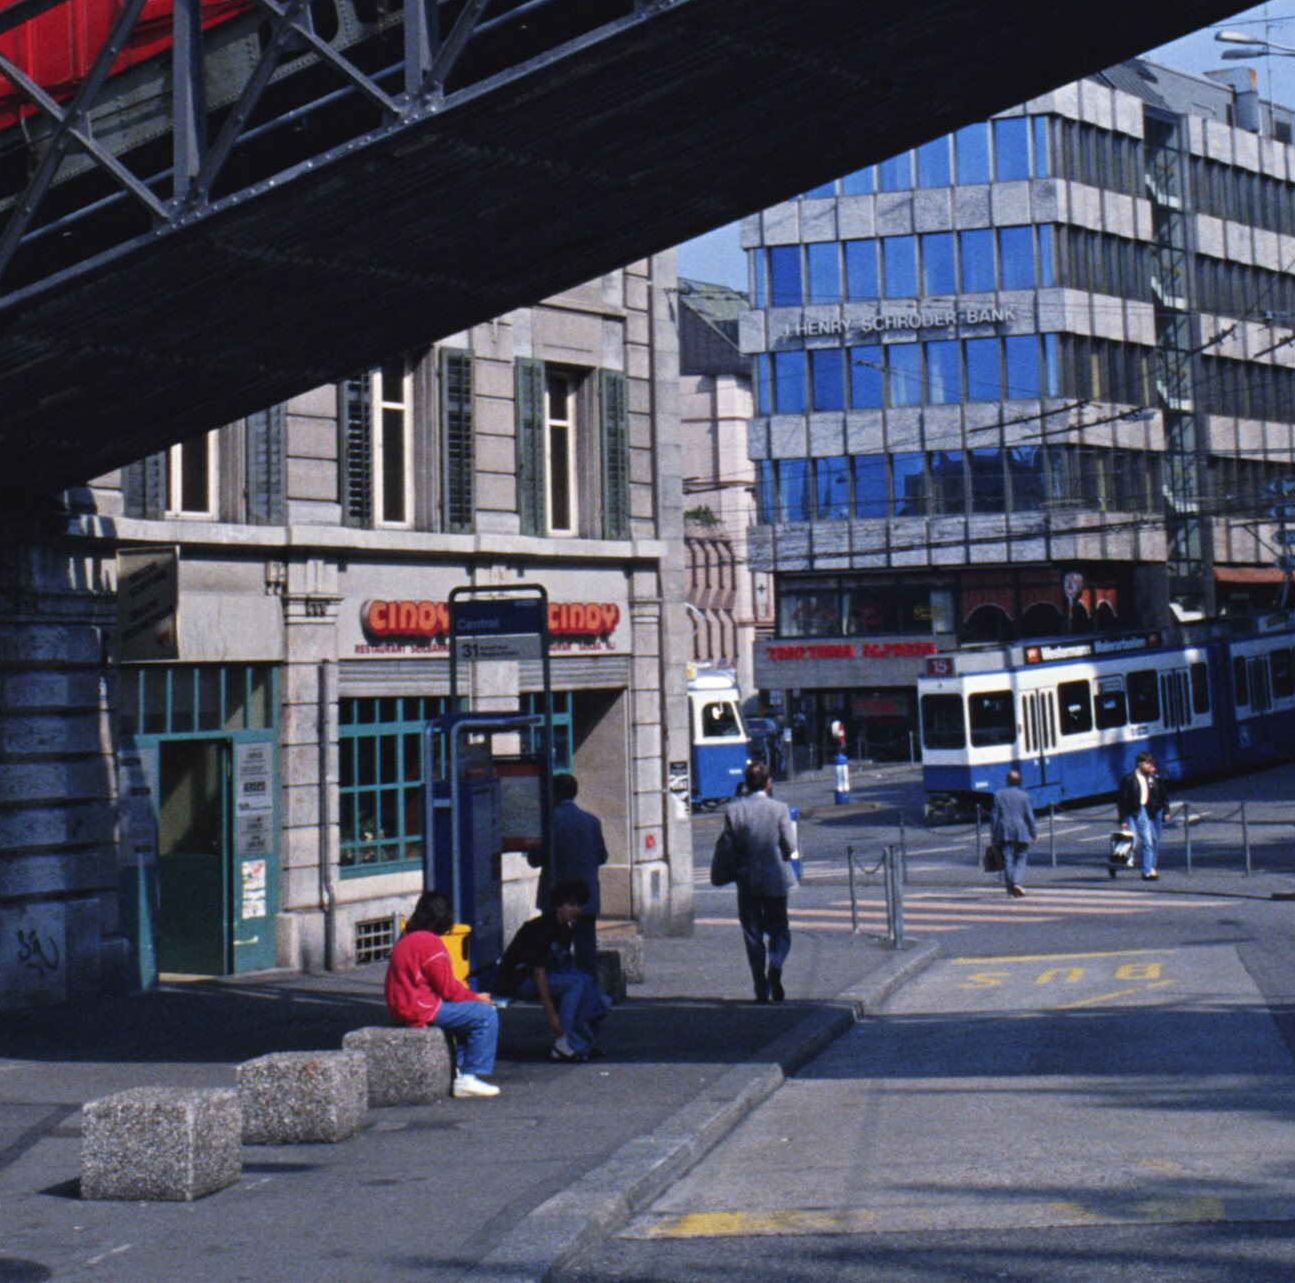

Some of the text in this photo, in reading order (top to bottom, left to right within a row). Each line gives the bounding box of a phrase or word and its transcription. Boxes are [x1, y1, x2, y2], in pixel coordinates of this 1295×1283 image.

[966, 307, 1017, 324] BANK
[456, 617, 499, 630] Central
[548, 601, 620, 636] CINDY
[462, 643, 479, 658] 31
[932, 659, 948, 674] 15
[957, 961, 1163, 990] BUS
